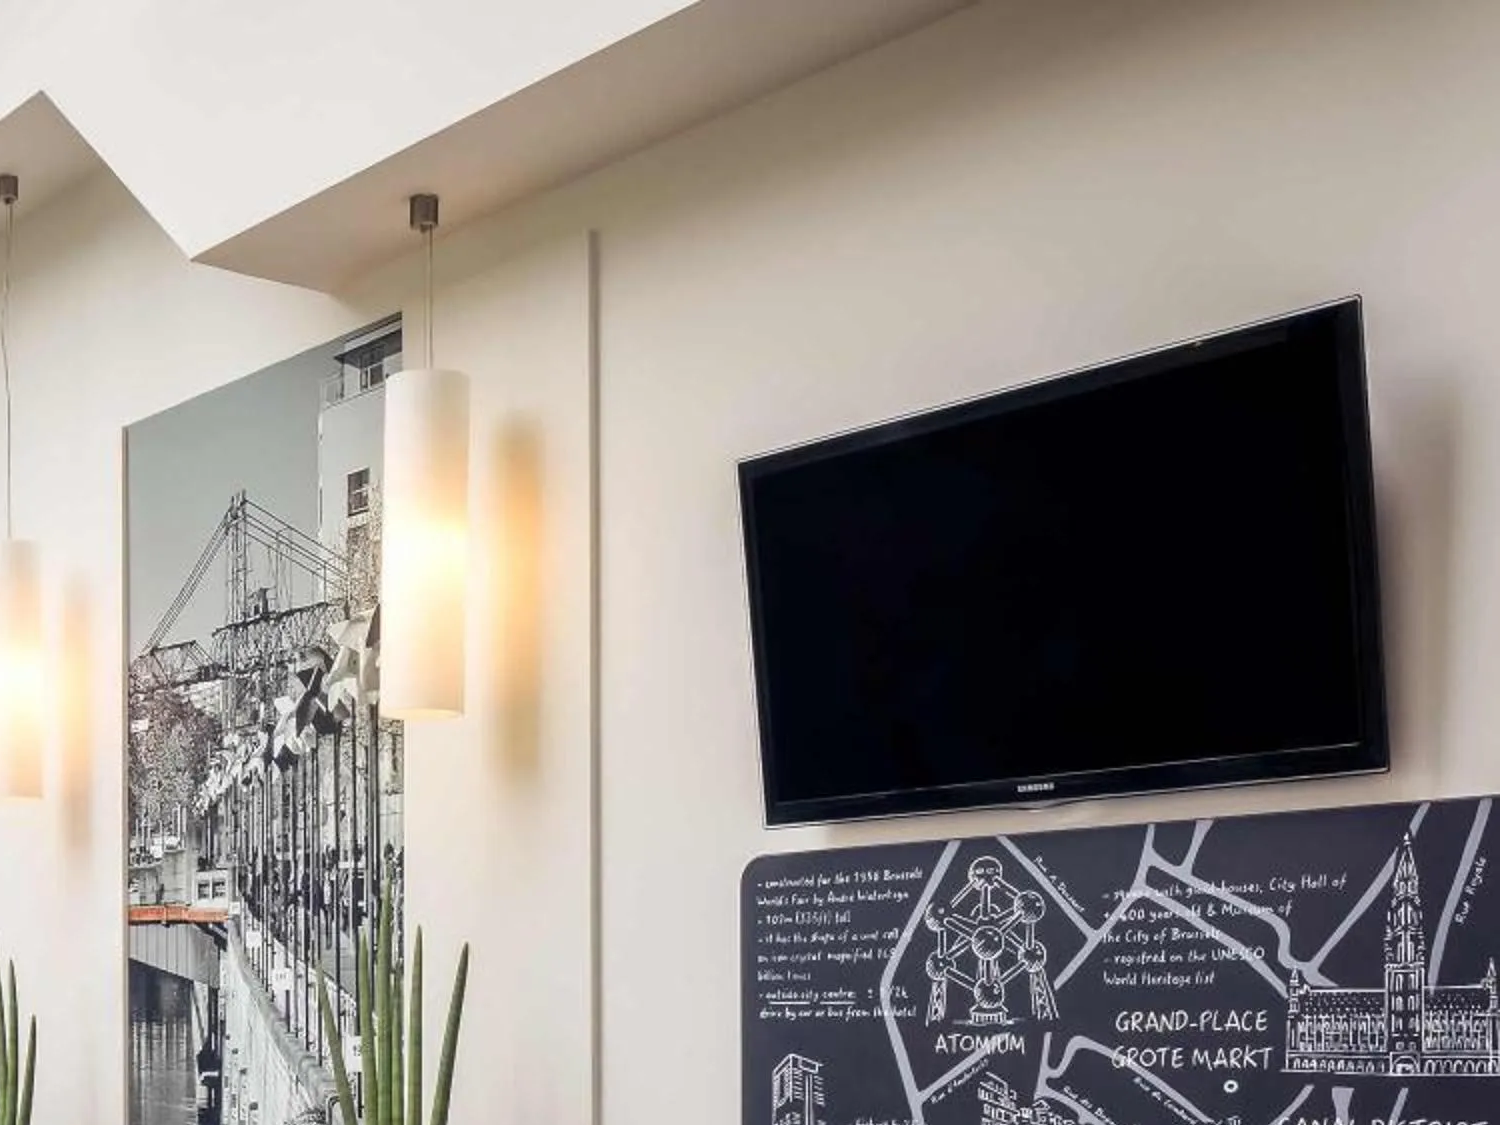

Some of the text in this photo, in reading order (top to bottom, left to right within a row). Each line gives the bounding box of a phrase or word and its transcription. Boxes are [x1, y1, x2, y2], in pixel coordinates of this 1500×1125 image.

[1269, 877, 1297, 892] City
[1301, 874, 1328, 888] Hall
[1331, 873, 1347, 890] of
[1207, 903, 1217, 916] &
[1278, 899, 1292, 917] of
[1125, 929, 1149, 945] City
[1154, 927, 1167, 945] of
[1170, 953, 1183, 963] on
[1187, 948, 1207, 963] the
[1211, 945, 1265, 962] UNESCO
[1103, 970, 1137, 986] World
[1141, 970, 1190, 987] Heritage
[1115, 1009, 1268, 1033] GRAND-PLACE
[935, 1033, 1025, 1055] ATOMIUM
[1111, 1044, 1273, 1071] GROTE MARKT
